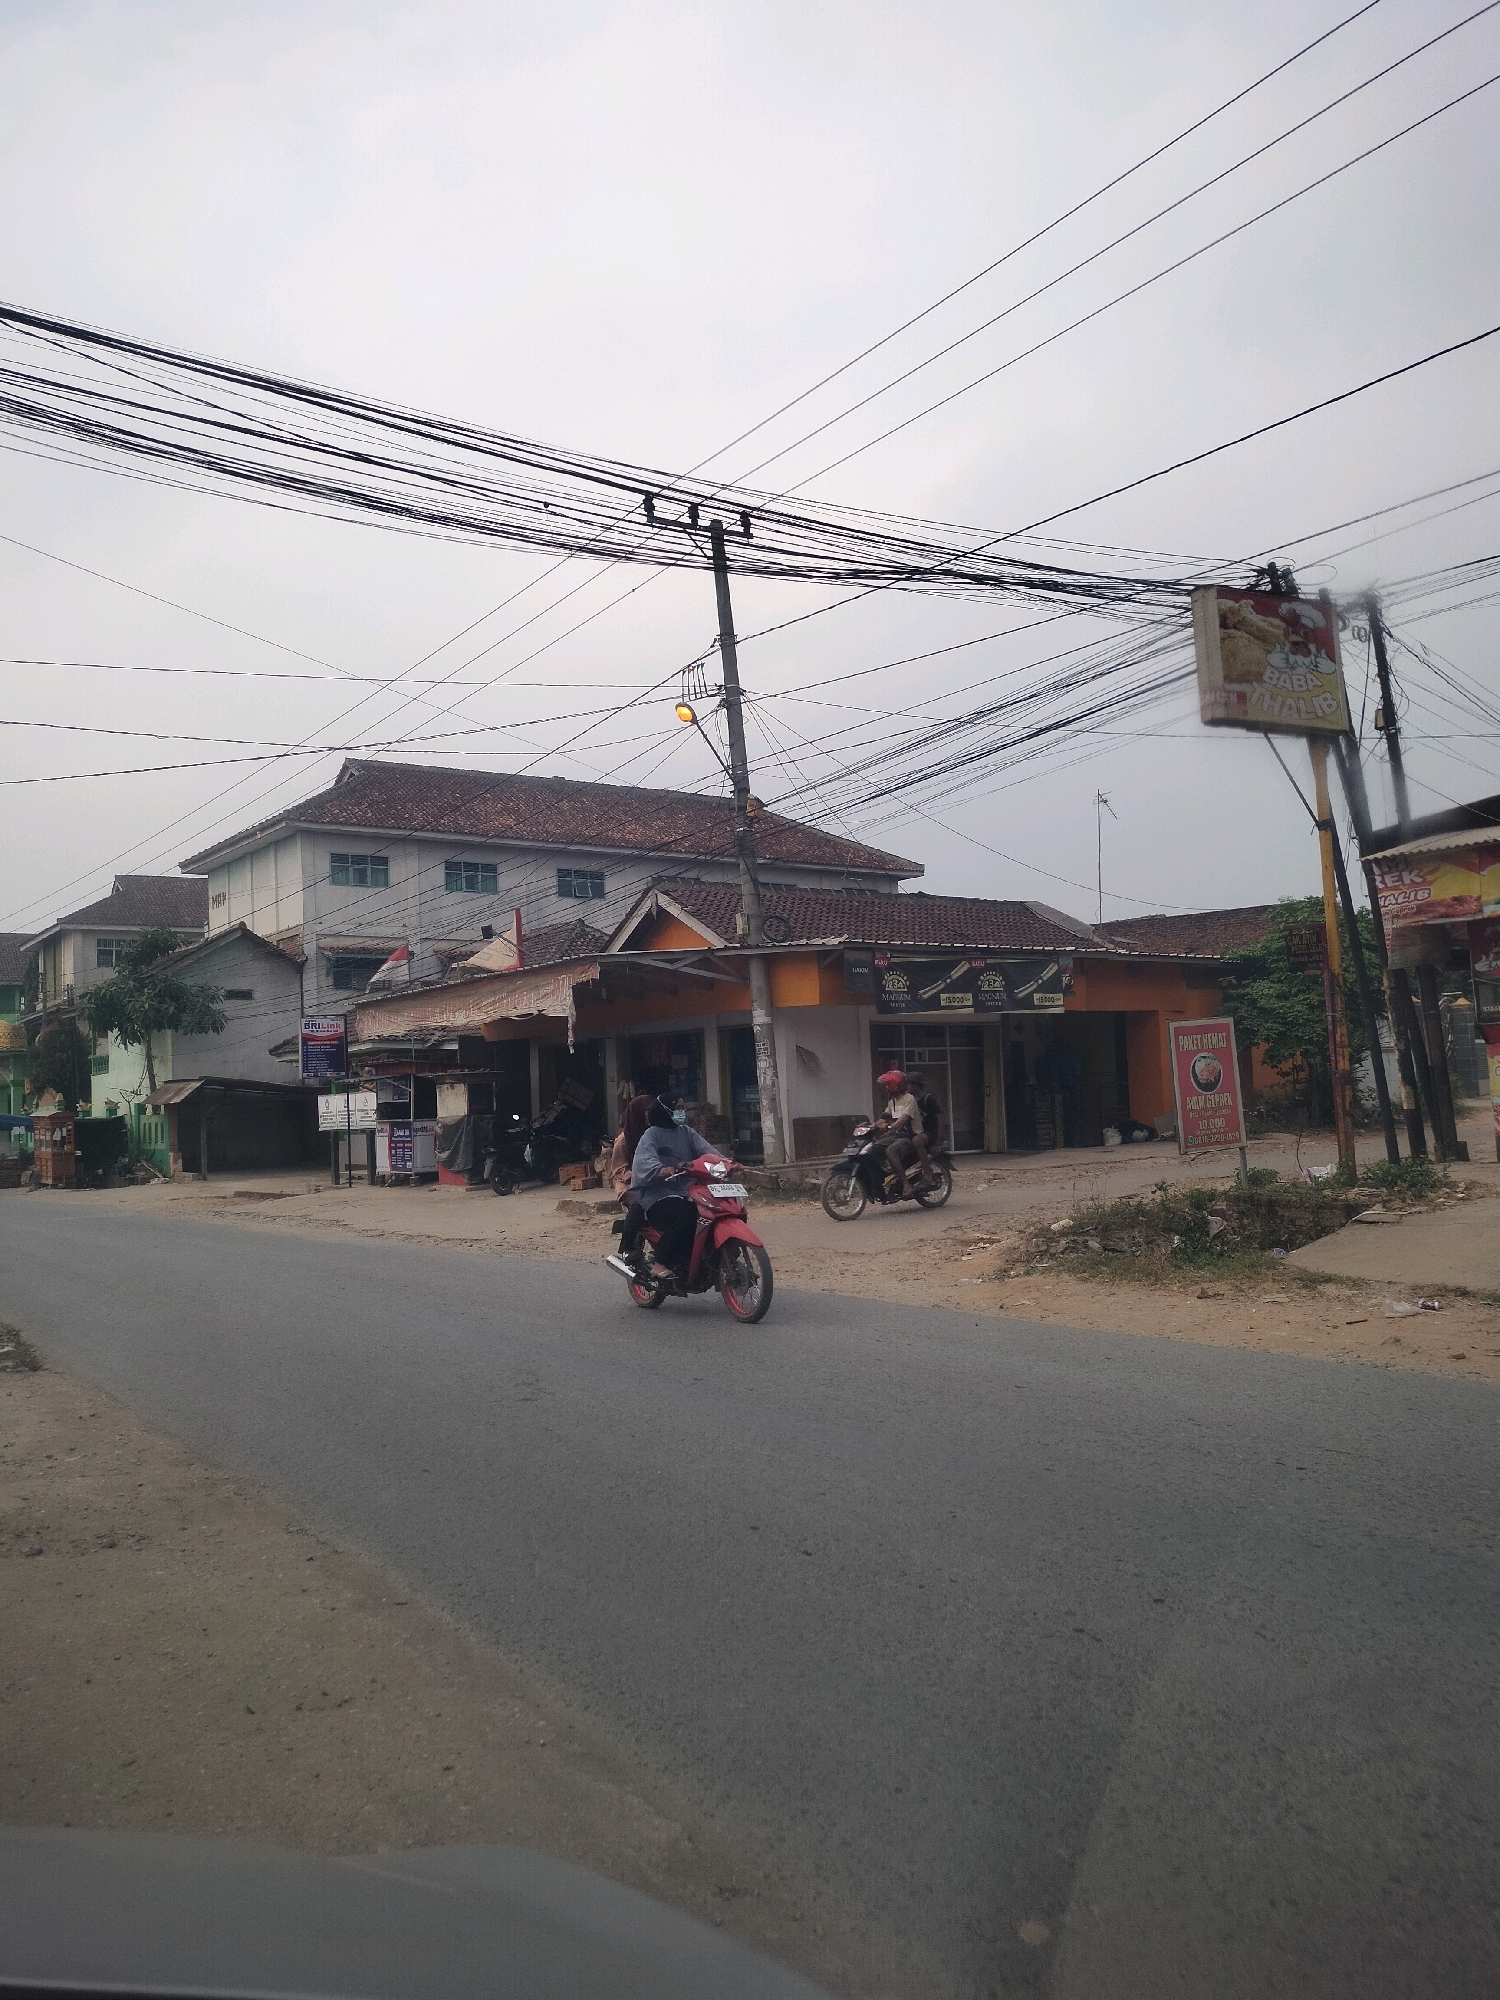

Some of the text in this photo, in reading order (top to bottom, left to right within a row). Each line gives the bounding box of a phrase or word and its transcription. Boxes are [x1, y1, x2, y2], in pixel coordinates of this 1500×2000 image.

[1262, 666, 1323, 692] BABA
[1249, 681, 1338, 720] THALIB
[888, 979, 905, 989] 234
[984, 979, 1000, 988] 234
[882, 993, 911, 1001] MAGNUM
[978, 993, 1007, 1001] MAGNUM
[304, 1022, 341, 1030] BRILink
[1179, 1032, 1227, 1051] PAKET HEMAT
[1186, 1093, 1233, 1110] AYAM GEPREK
[1198, 1118, 1226, 1129] 10.000
